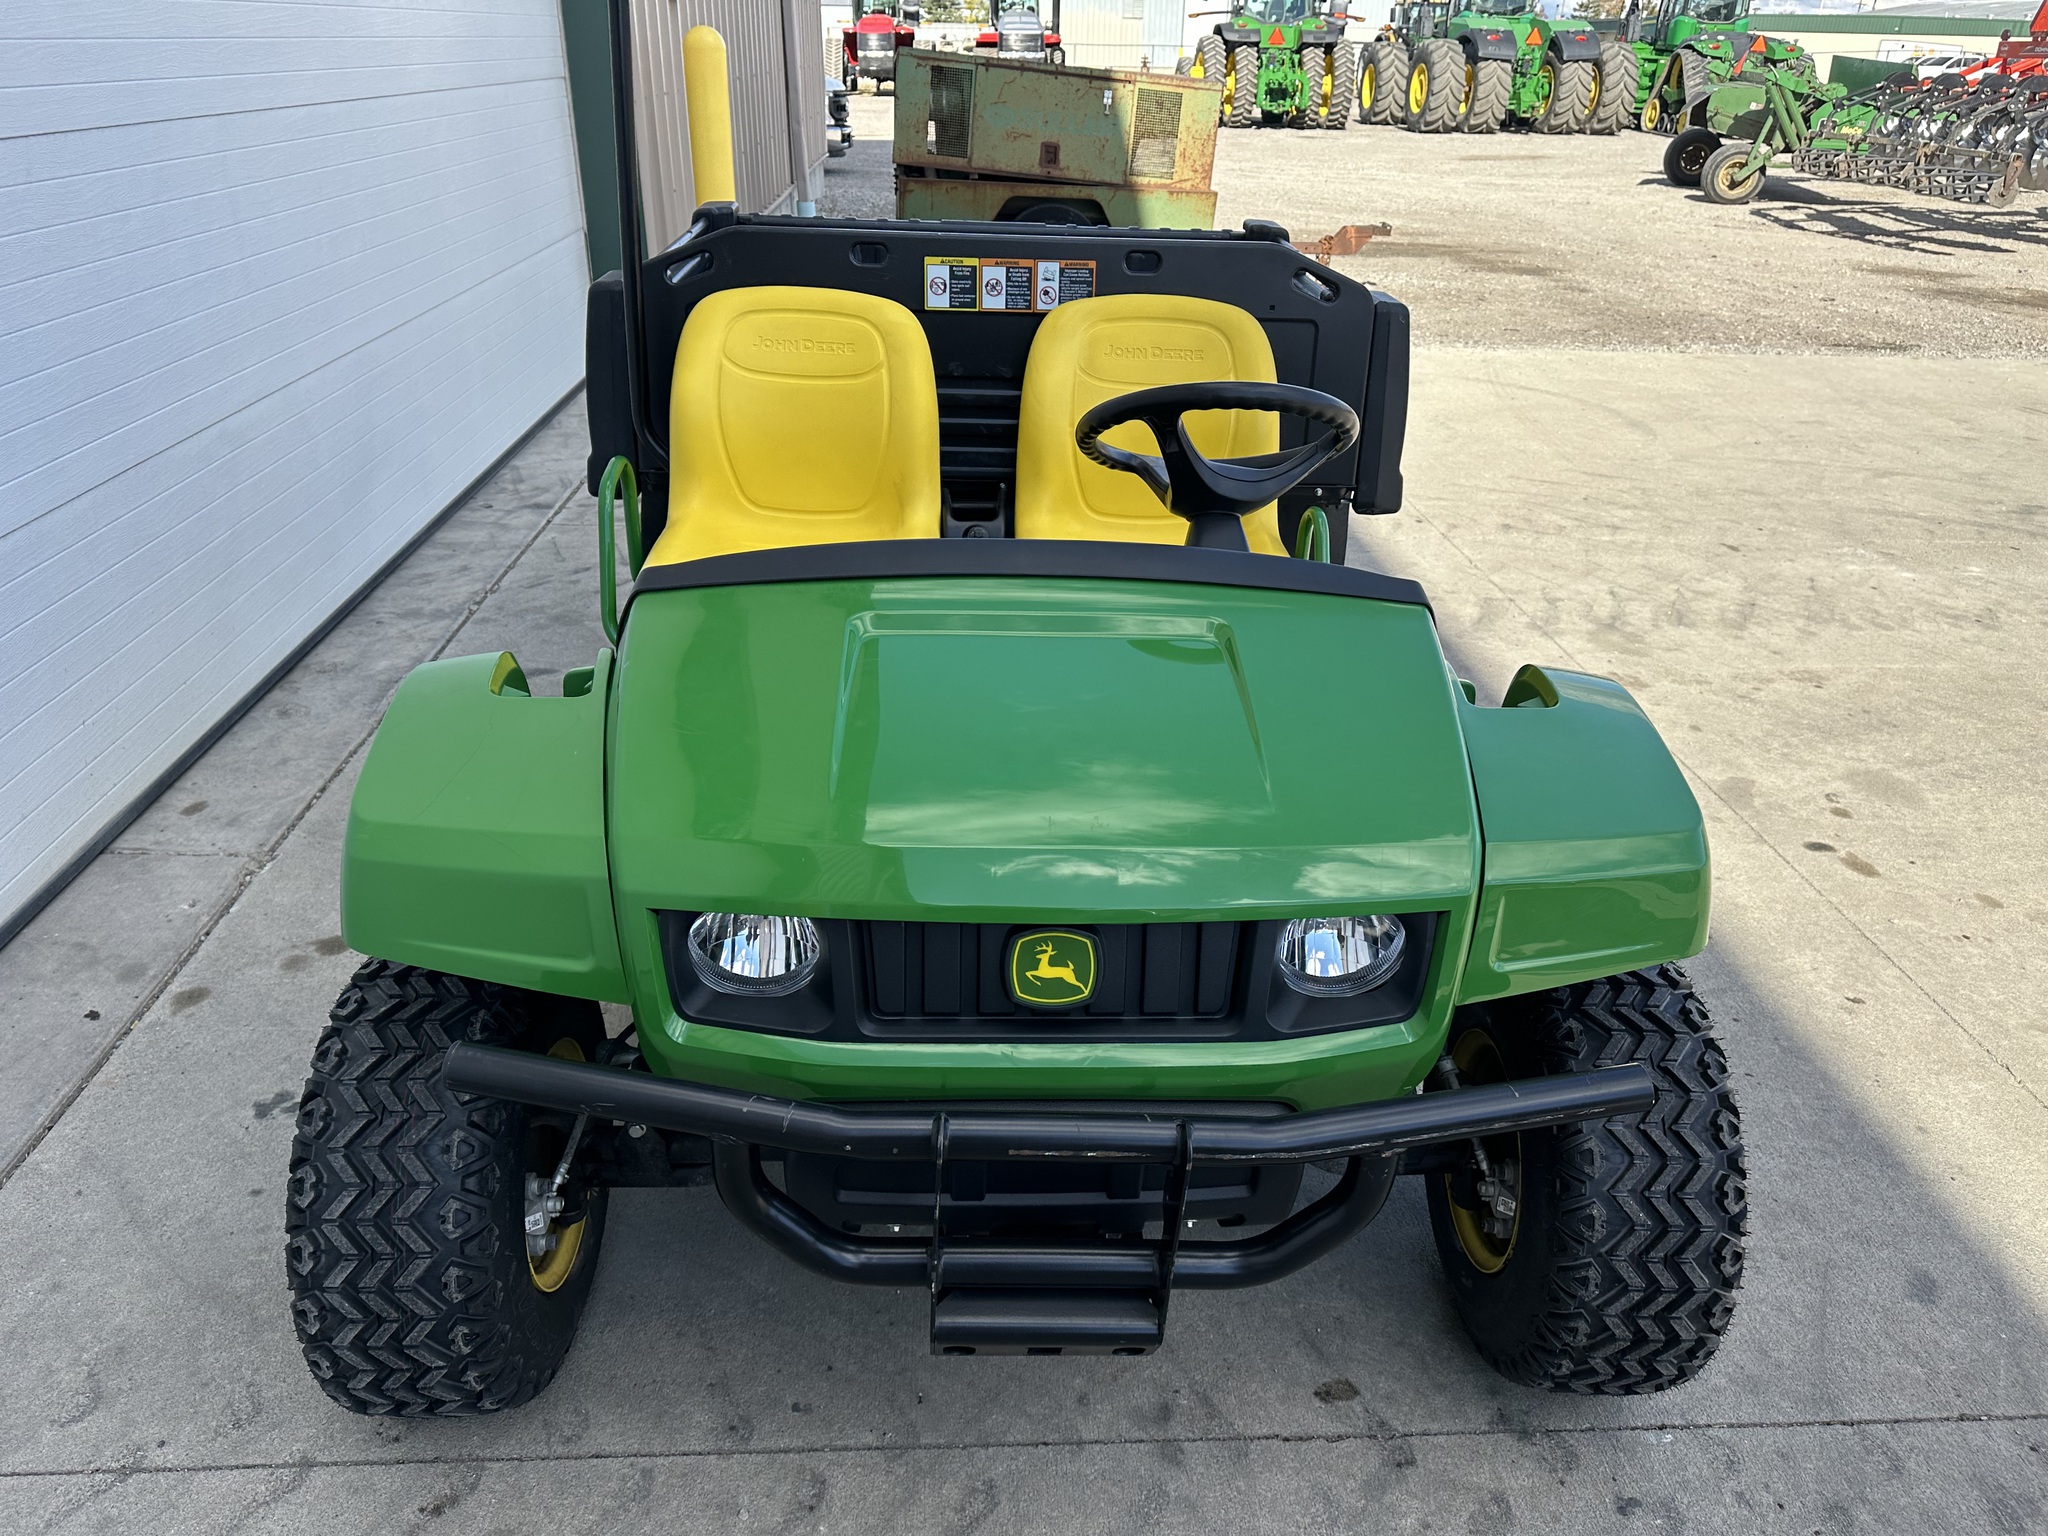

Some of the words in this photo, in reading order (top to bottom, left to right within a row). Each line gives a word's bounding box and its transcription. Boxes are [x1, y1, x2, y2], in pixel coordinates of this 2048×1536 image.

[752, 336, 799, 353] JOHN
[800, 338, 856, 356] DEERE
[1103, 344, 1148, 360] JOHN
[1150, 346, 1204, 362] DEERE
